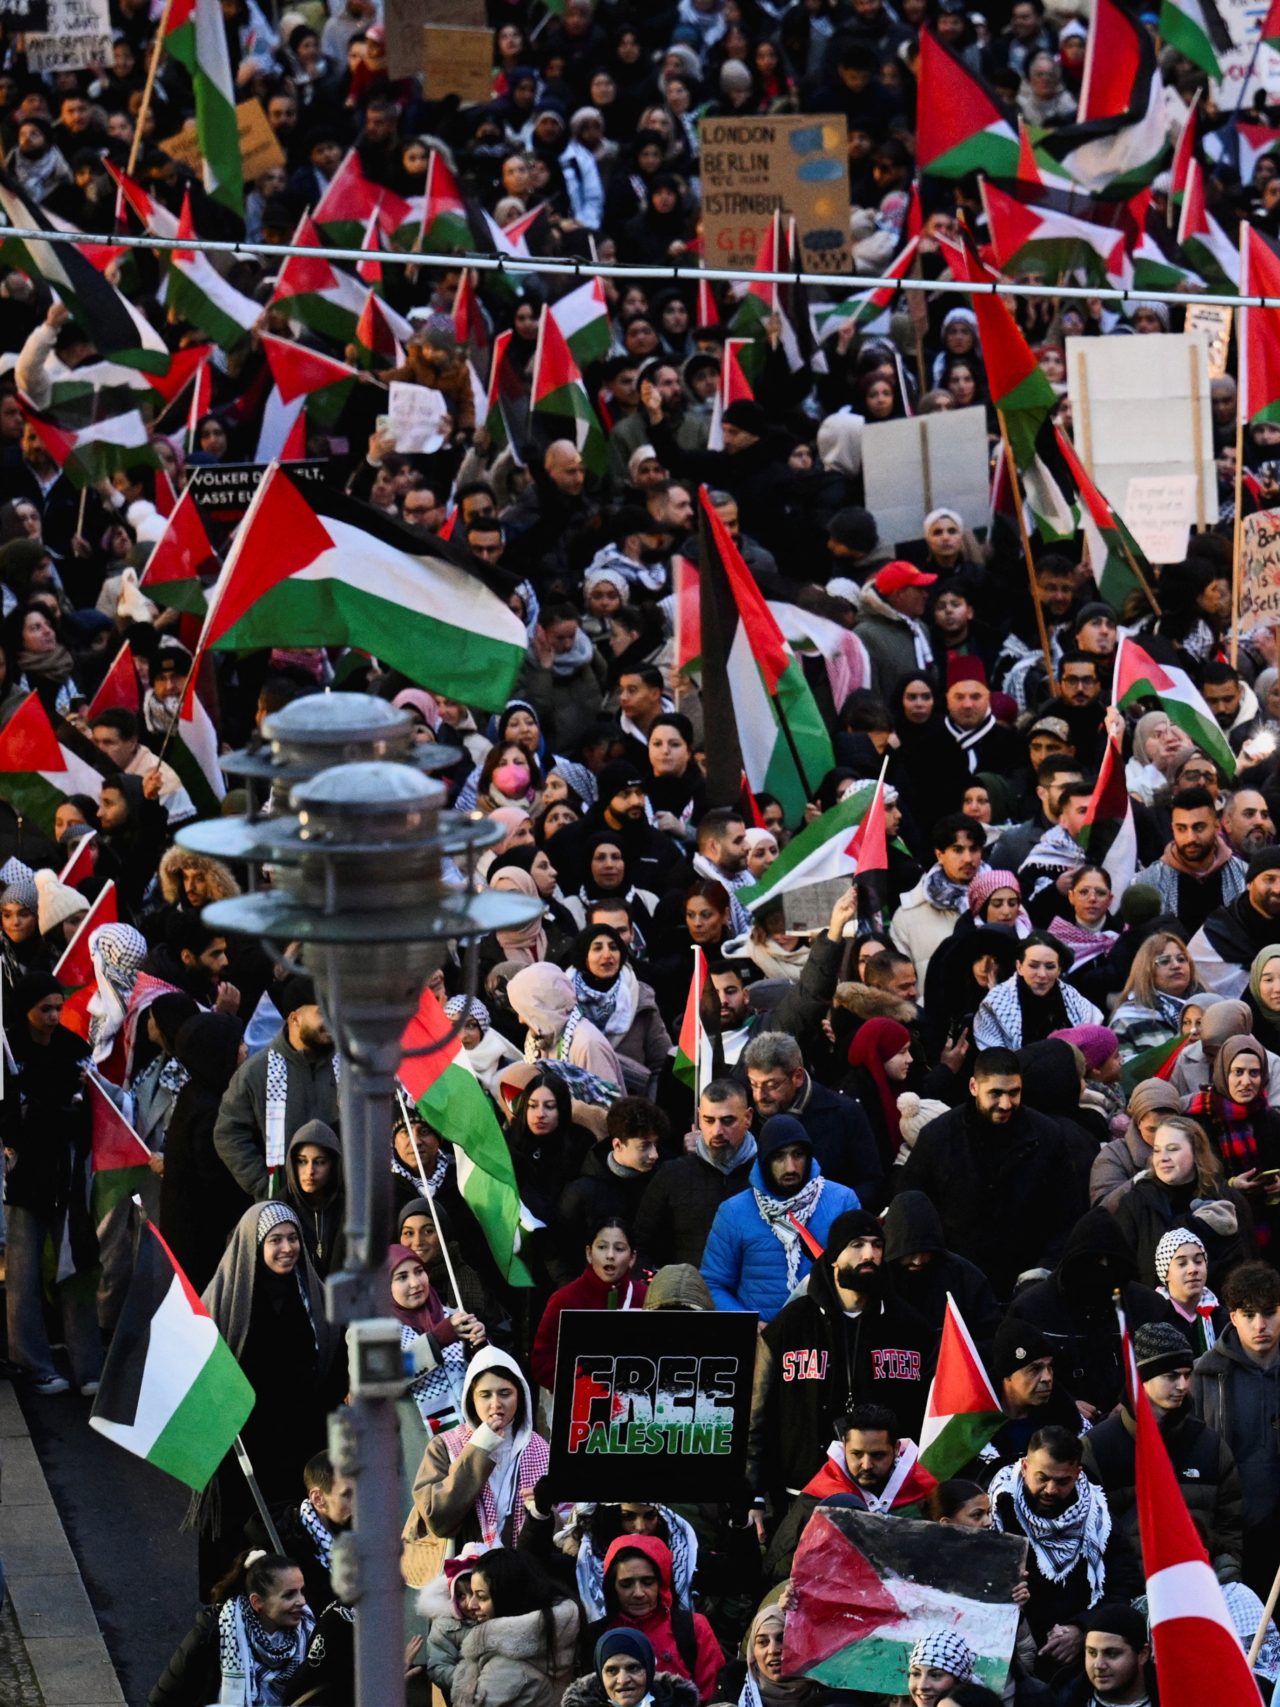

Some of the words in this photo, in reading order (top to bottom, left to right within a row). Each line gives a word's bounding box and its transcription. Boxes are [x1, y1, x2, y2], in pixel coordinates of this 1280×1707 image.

[702, 126, 776, 145] LONDON
[703, 153, 770, 173] BERLIN
[705, 192, 793, 215] ISTANBUL
[716, 227, 758, 250] GA
[194, 471, 249, 486] VÖLKER
[571, 1355, 739, 1424] FREE
[567, 1420, 734, 1455] PALESTINE
